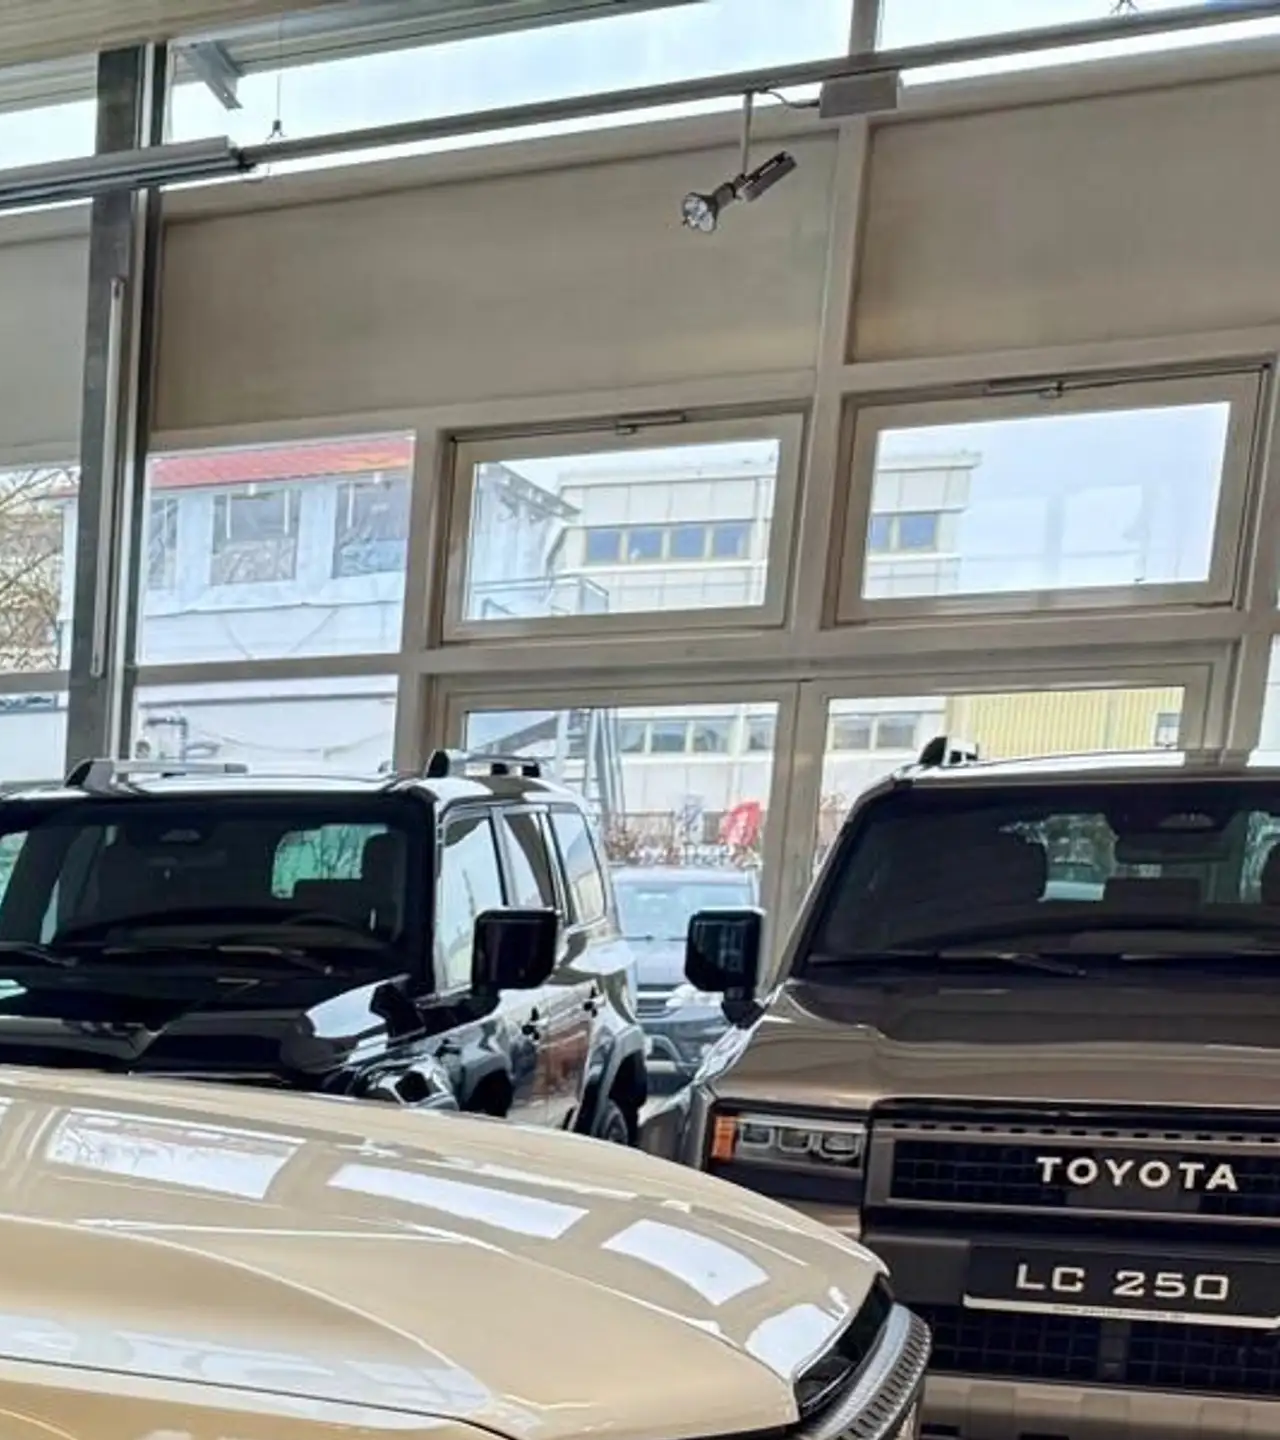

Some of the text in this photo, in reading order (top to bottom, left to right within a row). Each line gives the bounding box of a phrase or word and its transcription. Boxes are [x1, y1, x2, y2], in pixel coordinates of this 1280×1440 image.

[1036, 1156, 1239, 1192] TOYOTA
[1015, 1263, 1230, 1301] LC 250
